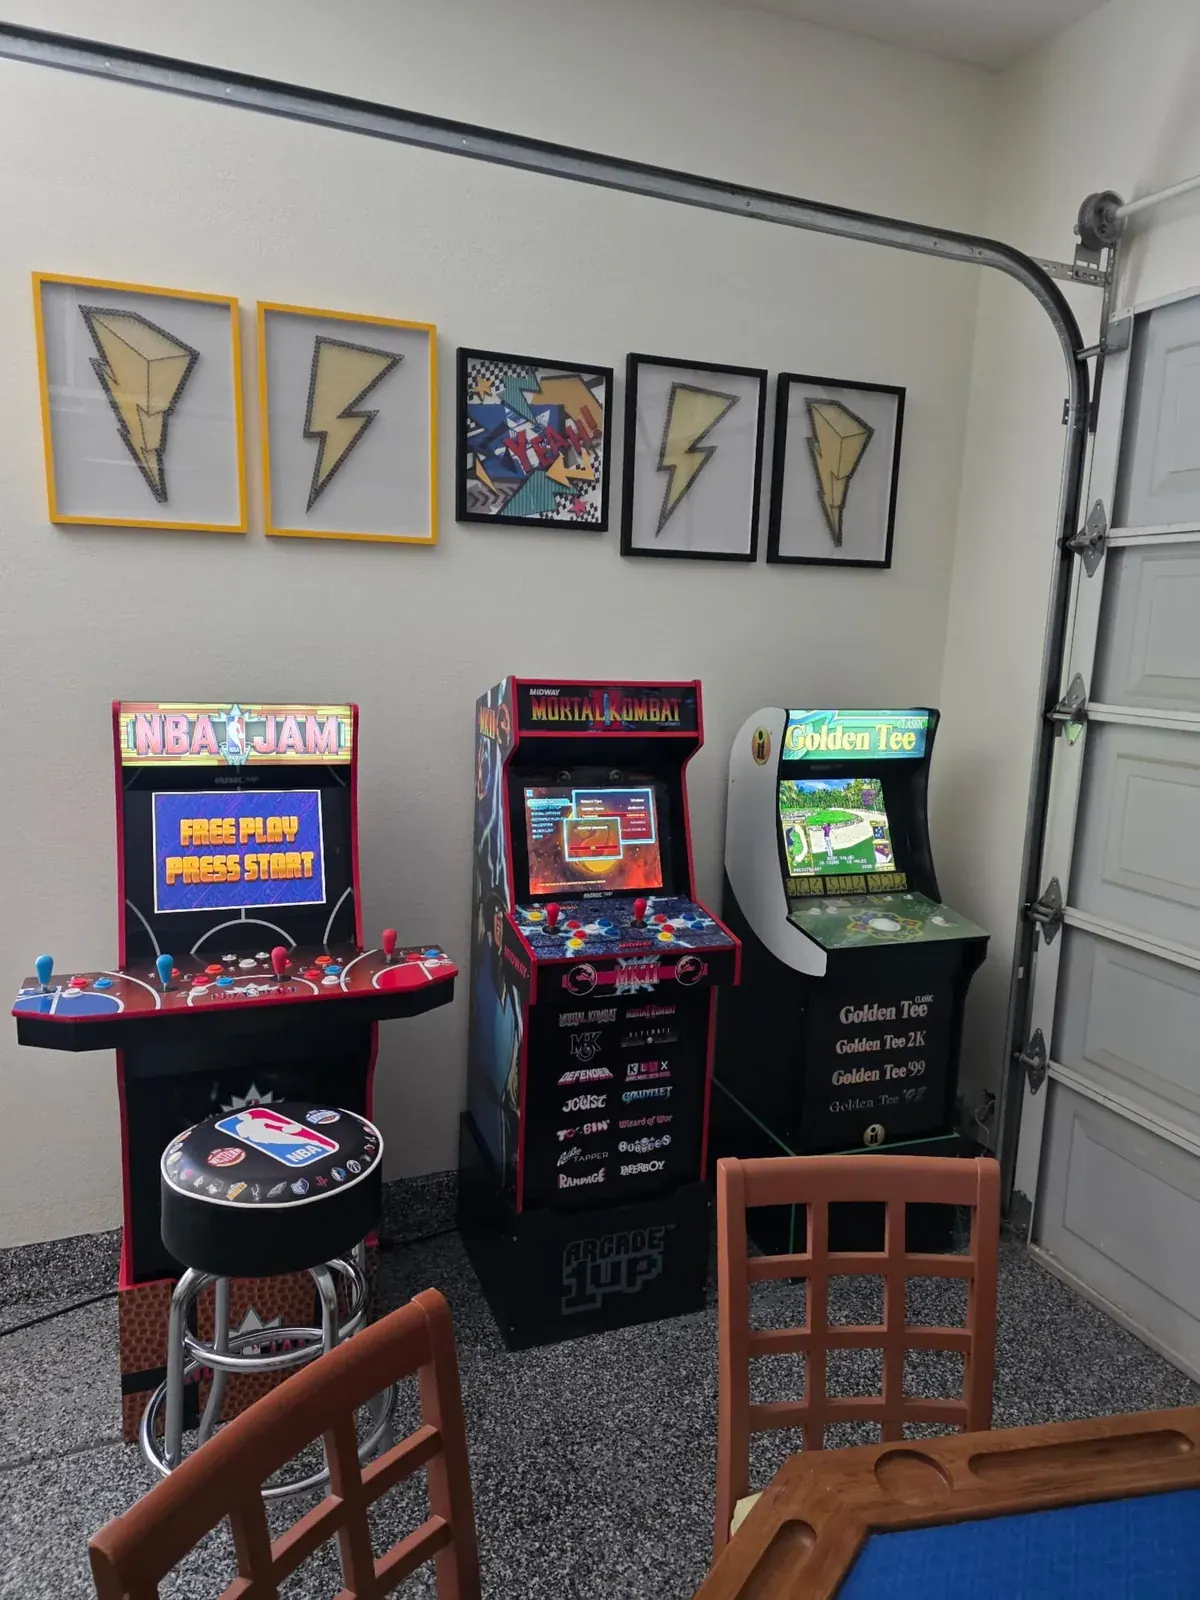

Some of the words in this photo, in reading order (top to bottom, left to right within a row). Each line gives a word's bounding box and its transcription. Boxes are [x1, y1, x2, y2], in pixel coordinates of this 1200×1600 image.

[529, 688, 560, 696] MIDWAY
[530, 697, 605, 722] MORTAL
[608, 696, 681, 722] KOMBAT
[135, 713, 220, 755] NBA
[252, 713, 340, 756] JAM
[785, 723, 870, 752] Golden
[876, 723, 916, 751] Tee
[180, 818, 236, 847] FREE
[239, 816, 299, 845] PLAY
[165, 854, 241, 885] PRESS
[244, 851, 314, 881] START
[839, 1003, 896, 1025] Golden
[900, 1000, 928, 1019] Tee
[836, 1038, 881, 1055] Golden
[884, 1034, 906, 1050] Tee
[907, 1030, 928, 1047] 2K
[558, 1067, 613, 1085] DEFENDER
[831, 1067, 880, 1086] Golden
[884, 1064, 906, 1080] Tee
[908, 1060, 926, 1077] '99
[562, 1094, 607, 1112] JOUST
[829, 1098, 875, 1113] Golden
[878, 1094, 899, 1106] Tee
[618, 1117, 646, 1128] Wizard
[647, 1115, 656, 1126] of
[286, 1144, 322, 1162] NBA
[573, 1151, 609, 1162] TAPPER
[557, 1167, 607, 1189] RAMPAGE
[563, 1226, 666, 1268] ARCADE
[561, 1250, 663, 1316] 1UP
